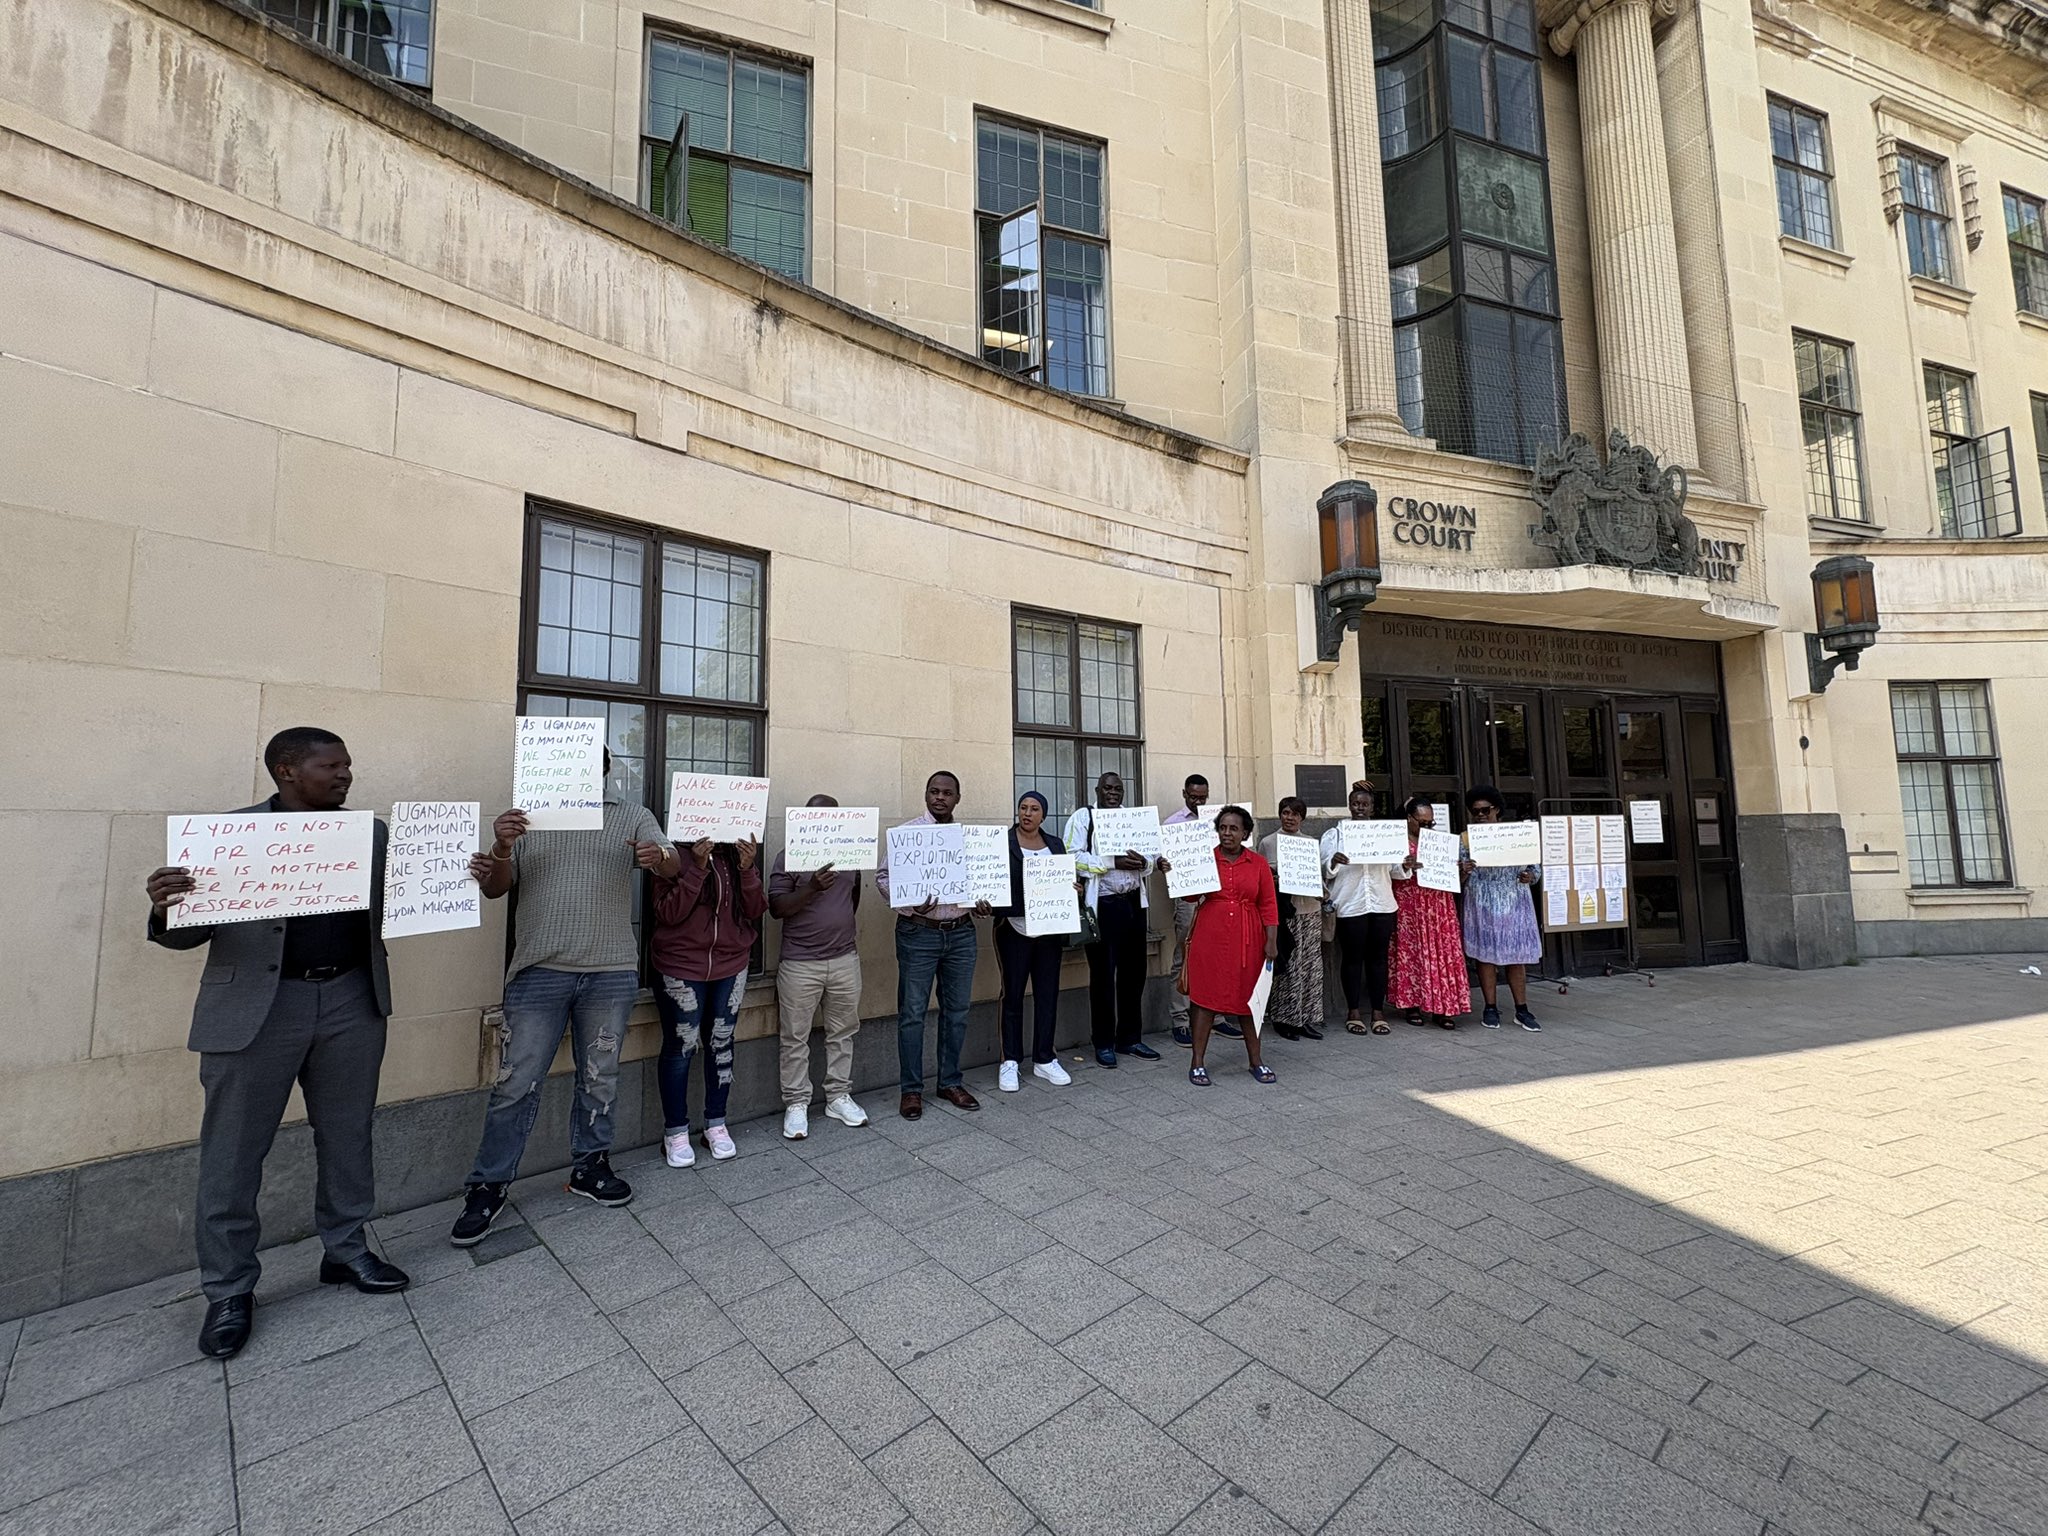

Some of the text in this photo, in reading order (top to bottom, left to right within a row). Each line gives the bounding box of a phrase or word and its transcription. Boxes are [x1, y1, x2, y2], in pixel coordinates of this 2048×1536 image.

[1388, 496, 1476, 528] CROWN
[1393, 522, 1475, 551] COURT
[1382, 620, 1440, 639] DISTRICT
[1445, 627, 1502, 644] REGISTRY
[1551, 635, 1579, 650] HIGH
[1583, 637, 1619, 653] COURT
[1456, 645, 1484, 659] AND
[1489, 647, 1541, 663] COUNTY
[1544, 651, 1583, 666] COURT
[521, 718, 596, 732] AS UGANDAN
[522, 748, 587, 762] WE STAND
[579, 764, 594, 777] IN
[675, 777, 717, 790] WAKE
[729, 780, 743, 791] UP
[519, 798, 551, 813] LYDIA
[676, 797, 758, 812] AFRICAN JUDGE
[397, 802, 472, 823] UGANDAN
[1131, 810, 1150, 819] NOT
[181, 818, 348, 837] LYDIA IS NOT
[799, 824, 845, 834] WITHOUT
[890, 831, 945, 849] WHO IS
[965, 841, 992, 850] RITAIN
[1360, 841, 1375, 849] NOT
[177, 843, 316, 862] A PR CASE
[893, 848, 963, 867] EXPLOITING
[234, 865, 252, 876] IS
[270, 861, 360, 876] MOTHER
[391, 857, 471, 878] WE STAND
[1025, 858, 1056, 869] THIS IS
[919, 866, 947, 880] WHO
[1176, 869, 1196, 880] NOT
[238, 880, 323, 894] FAMILY
[387, 880, 407, 900] TO
[896, 884, 909, 899] IN
[911, 882, 941, 898] THIS
[972, 881, 1007, 891] DOMESTIC
[1031, 887, 1051, 898] NOT
[1171, 880, 1178, 891] A
[177, 894, 360, 920] DESSERVE JUSTICE
[387, 898, 479, 922] LYDIA MUGAMBE
[1028, 900, 1073, 910] DOMESTIC
[1029, 911, 1071, 922] SLAVERY
